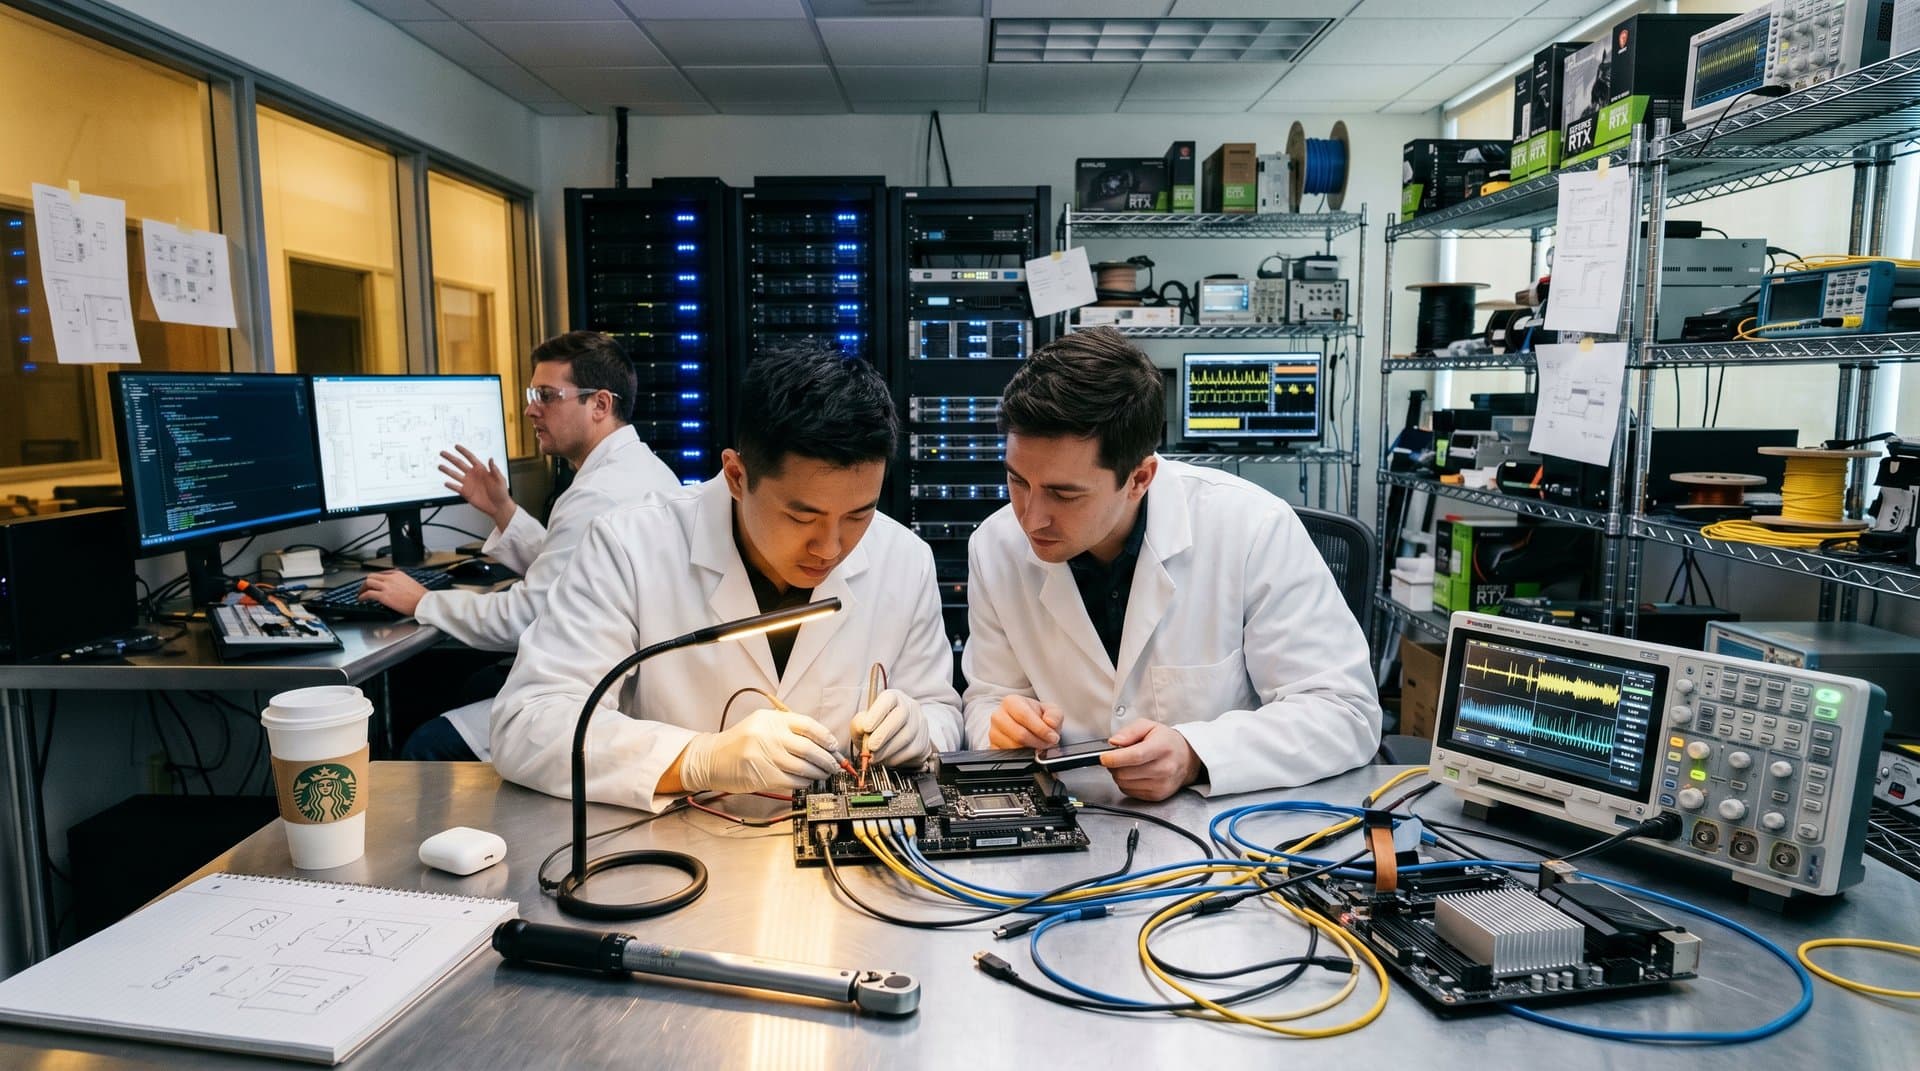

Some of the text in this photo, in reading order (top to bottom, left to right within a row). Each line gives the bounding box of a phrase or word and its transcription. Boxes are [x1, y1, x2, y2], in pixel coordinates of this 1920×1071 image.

[1608, 113, 1629, 131] RTX
[1568, 127, 1592, 152] RTX
[1511, 152, 1528, 169] RTX
[1529, 144, 1547, 161] RTX
[1129, 198, 1152, 209] RTX
[1174, 191, 1194, 202] RTX
[1476, 591, 1507, 605] RTX
